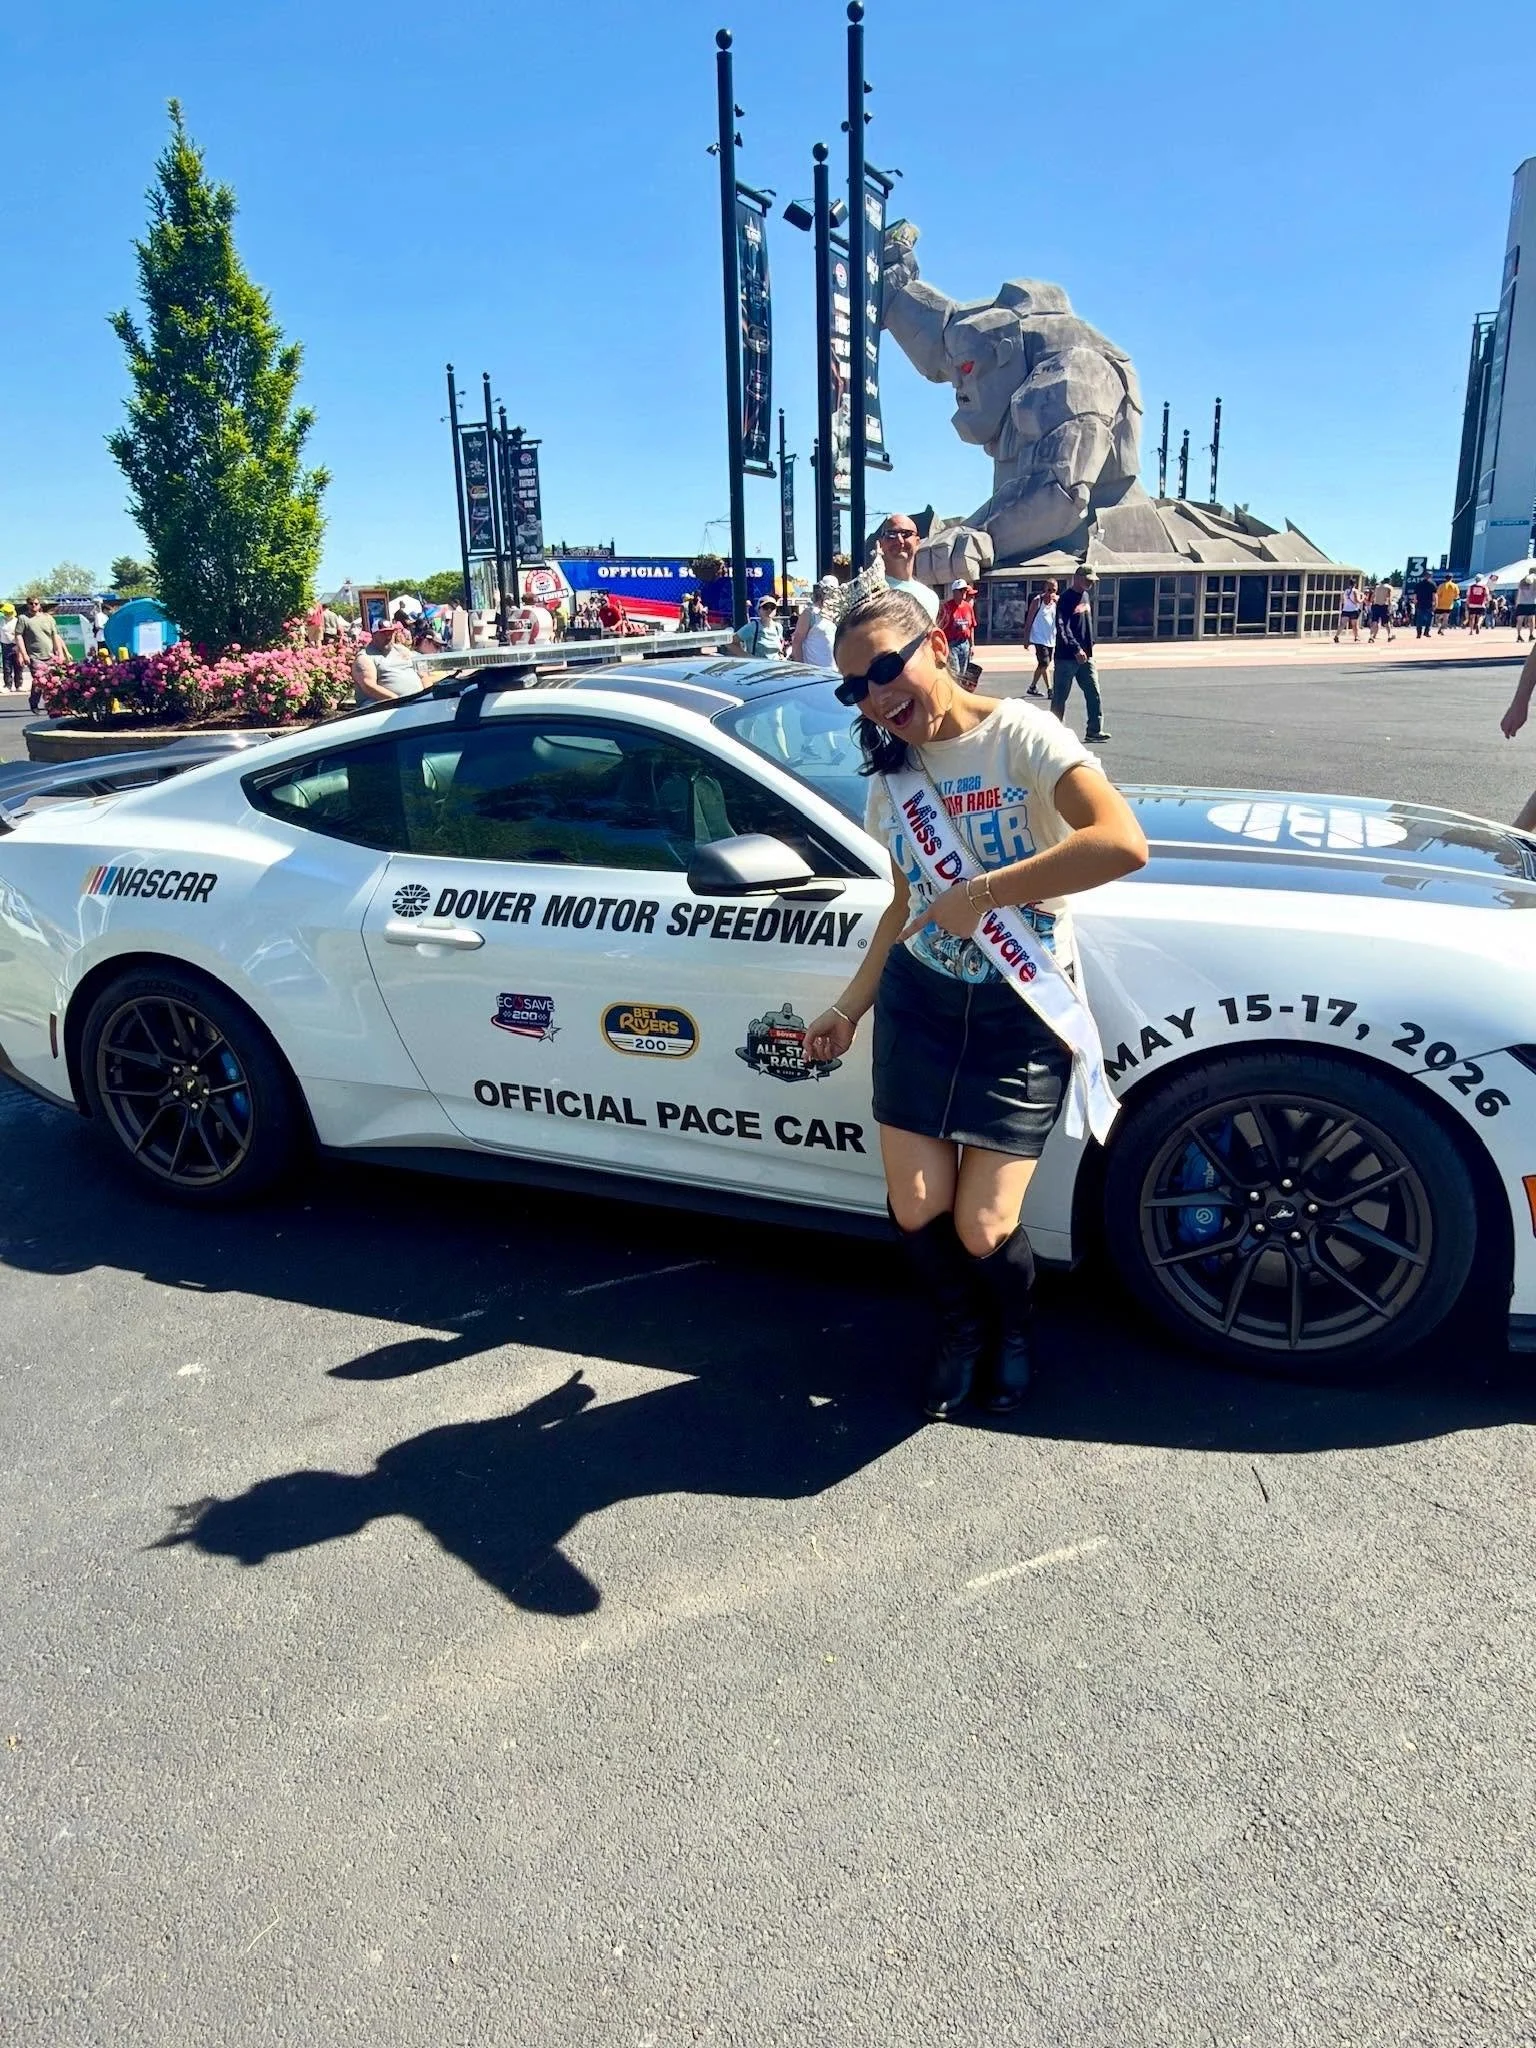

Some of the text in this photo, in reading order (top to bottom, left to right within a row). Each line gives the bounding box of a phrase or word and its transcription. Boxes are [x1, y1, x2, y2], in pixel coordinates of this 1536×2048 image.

[598, 566, 673, 578] OFFICIAL
[1409, 558, 1424, 577] 3
[966, 788, 1003, 812] RACE
[902, 789, 942, 856] Miss
[110, 866, 218, 903] NASCAR
[433, 887, 862, 948] DOVER MOTOR SPEEDWAY
[512, 1010, 538, 1020] 200
[633, 1007, 658, 1019] BET
[635, 1038, 667, 1051] 200
[1104, 993, 1511, 1117] MAY 15-17, 2026
[770, 1056, 805, 1069] RACE
[473, 1079, 867, 1154] OFFICIAL PACE CAR
